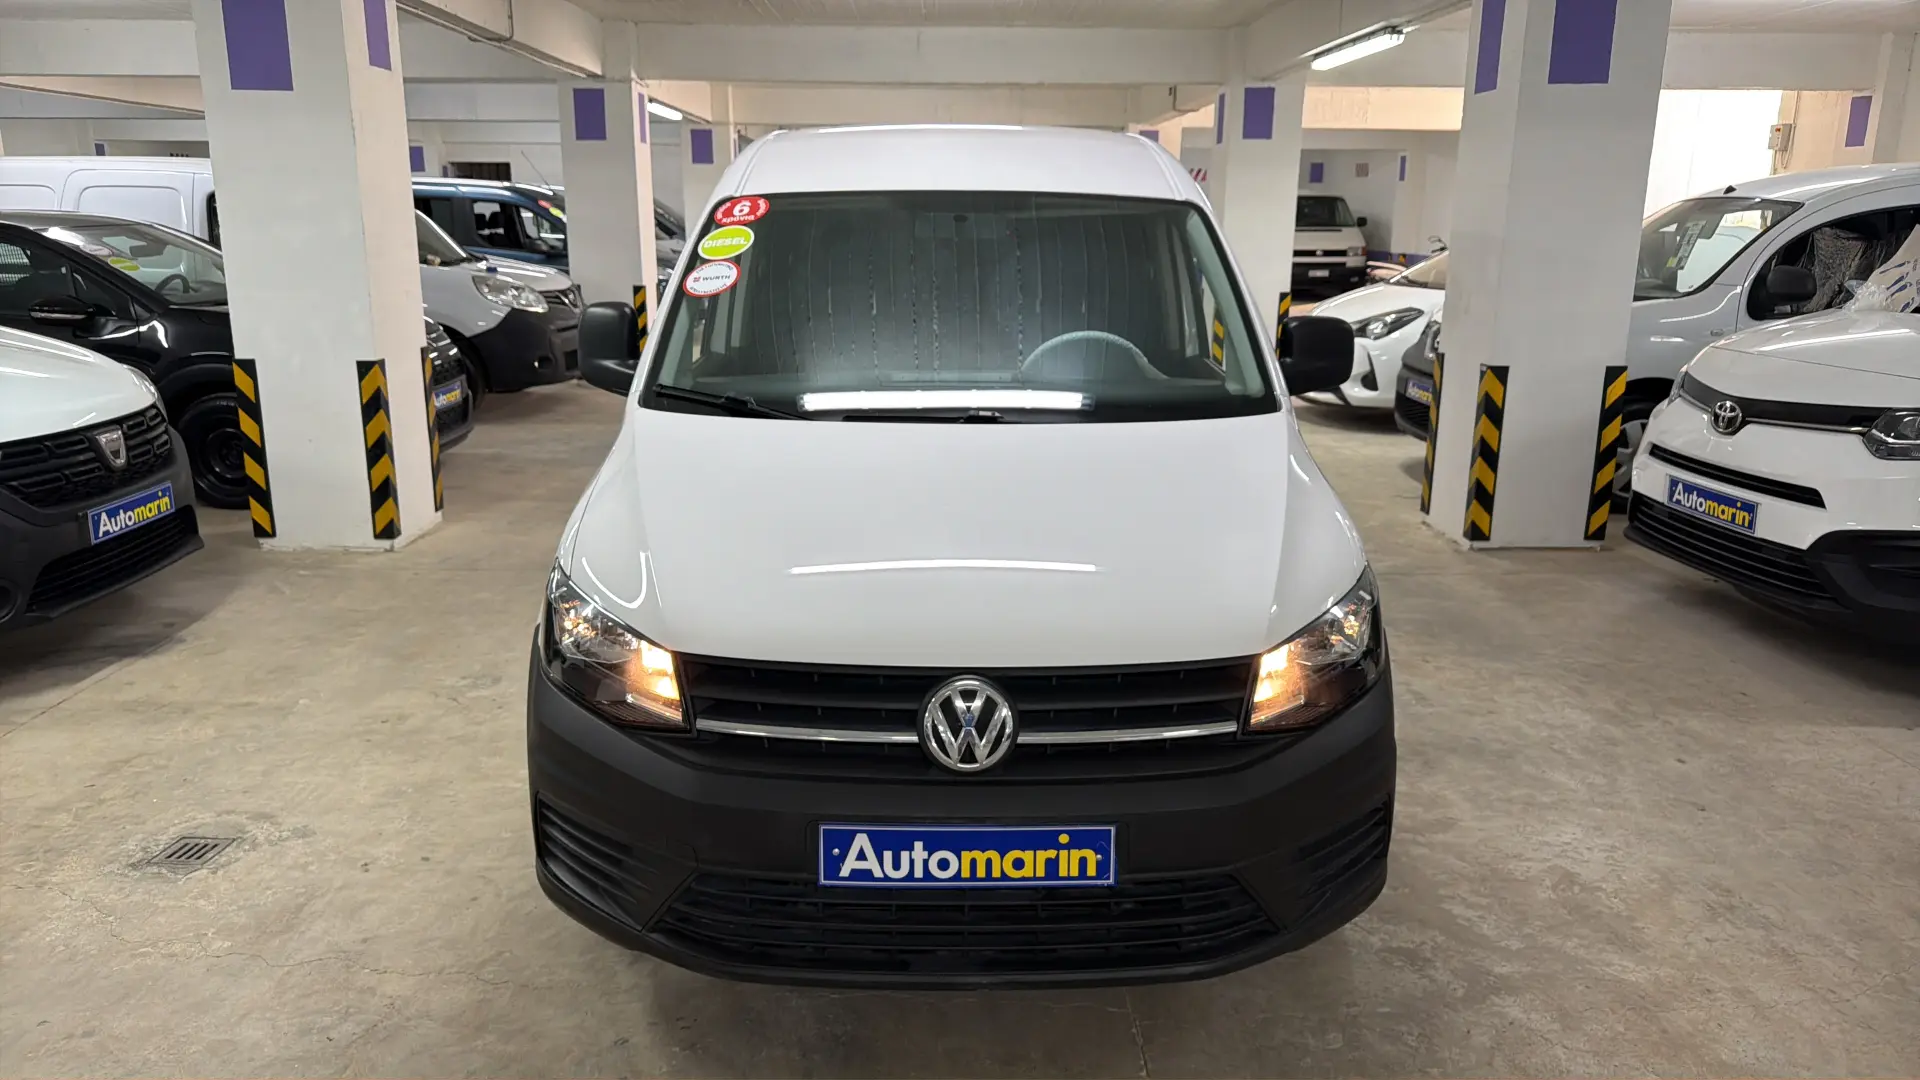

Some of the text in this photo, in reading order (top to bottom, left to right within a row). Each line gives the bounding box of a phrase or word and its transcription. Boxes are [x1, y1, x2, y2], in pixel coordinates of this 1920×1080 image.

[733, 201, 751, 216] 6
[704, 237, 748, 248] DIESEL
[98, 490, 170, 537] Automarin
[1672, 482, 1750, 528] Automarin
[839, 833, 1097, 880] Automarin
